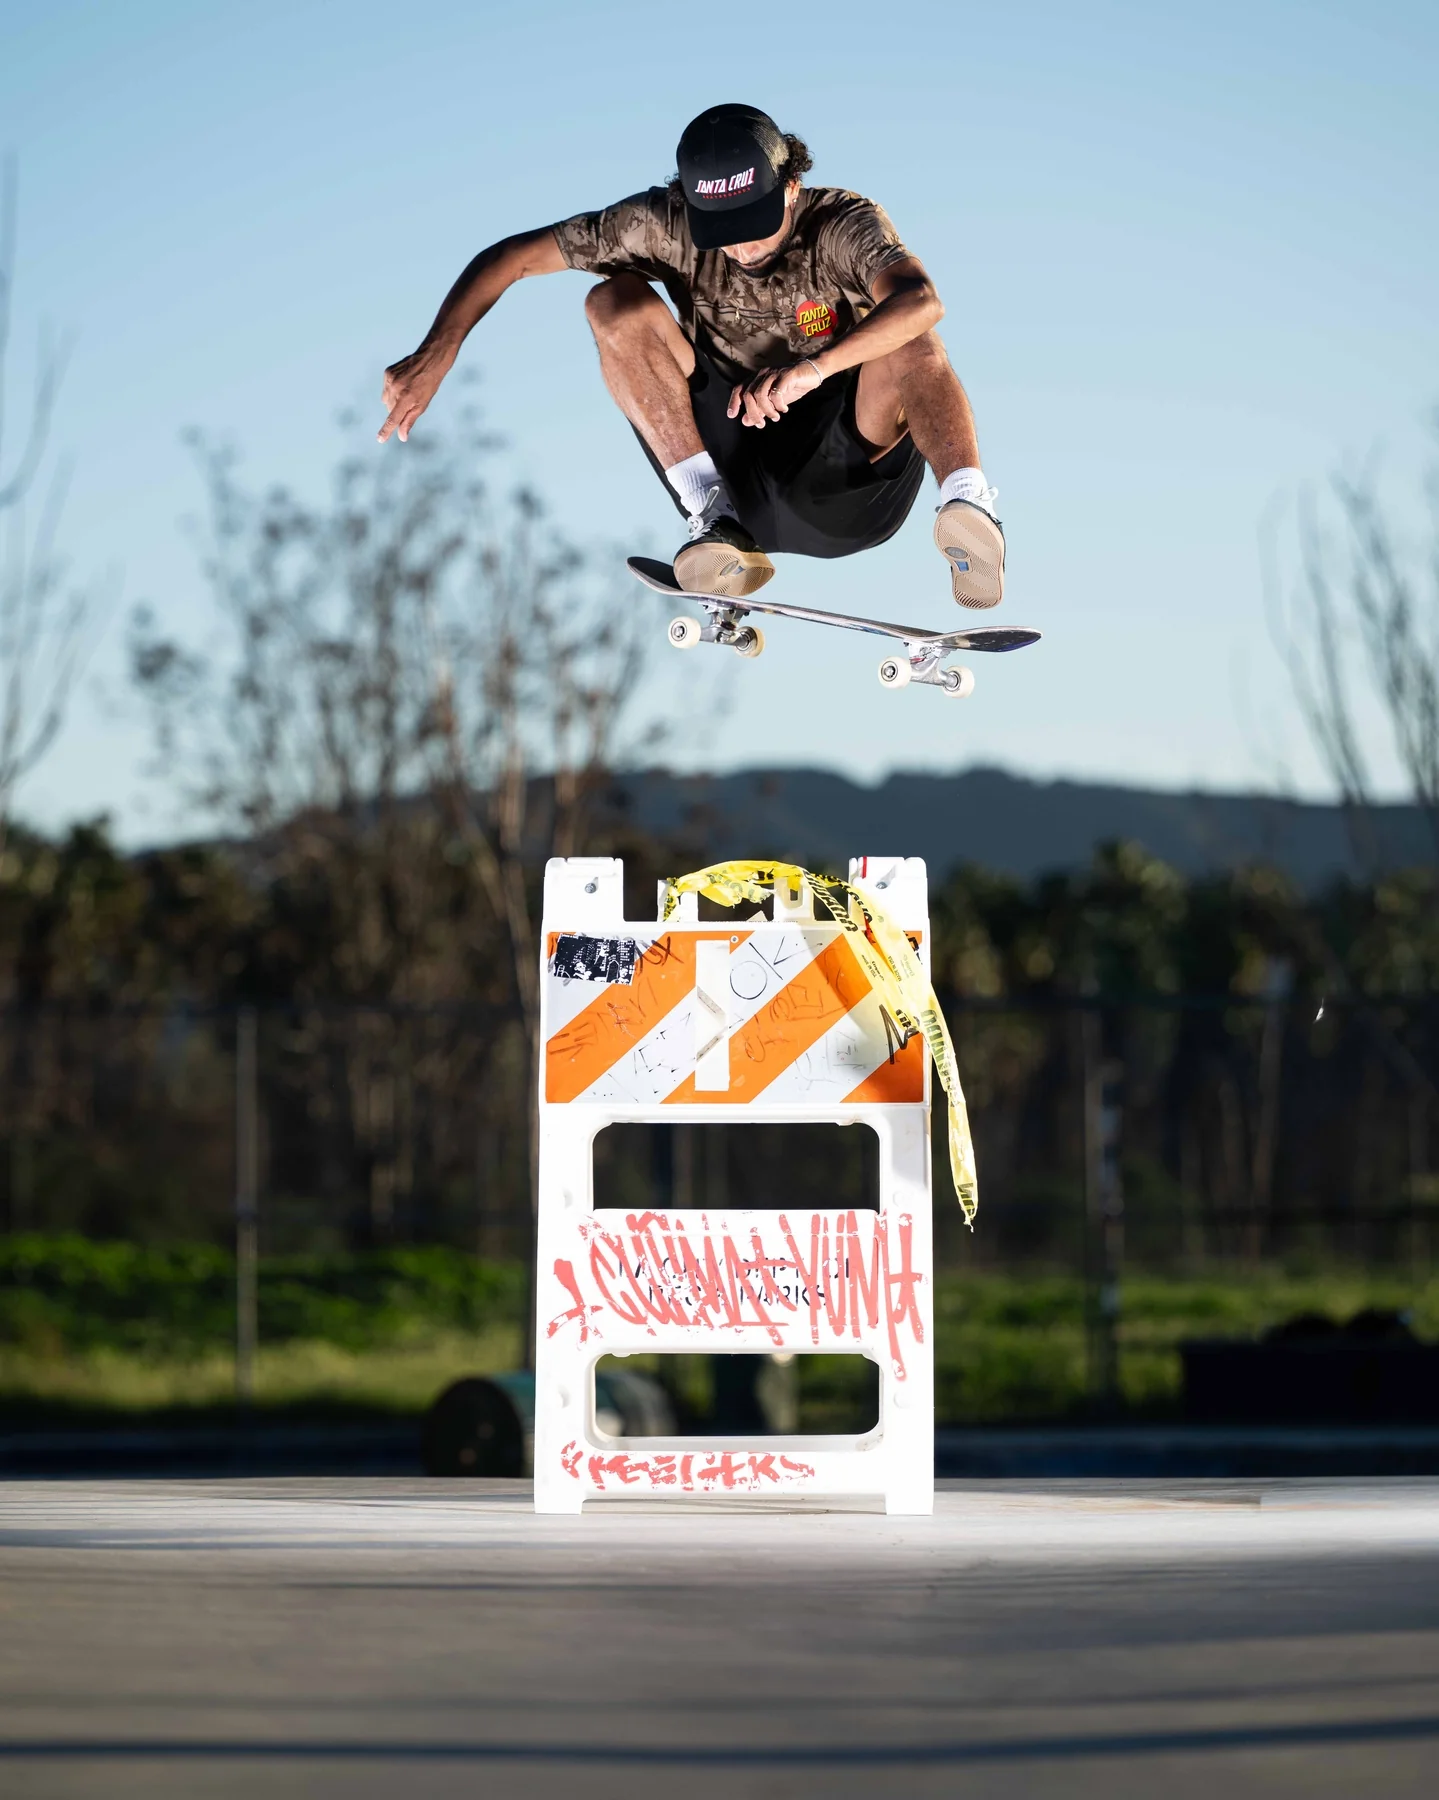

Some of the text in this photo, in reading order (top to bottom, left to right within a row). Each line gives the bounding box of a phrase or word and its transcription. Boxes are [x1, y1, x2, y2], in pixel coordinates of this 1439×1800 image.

[695, 167, 755, 194] SANTA CRUZ
[796, 303, 829, 326] SANTA
[805, 315, 831, 337] CRUZ
